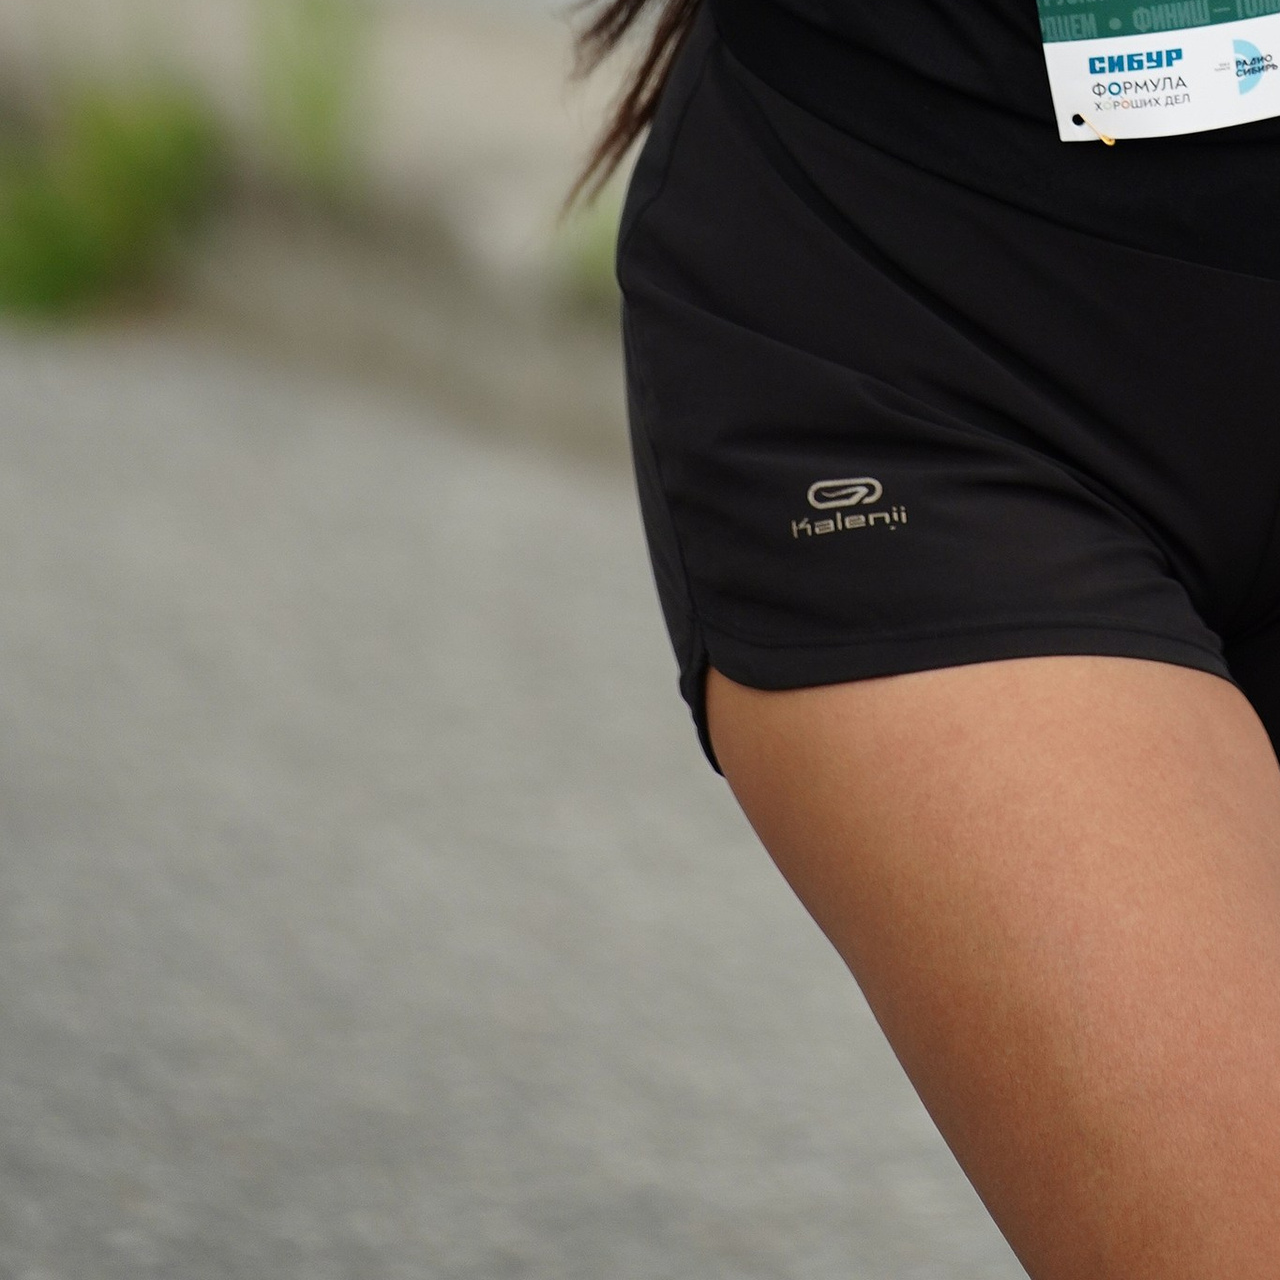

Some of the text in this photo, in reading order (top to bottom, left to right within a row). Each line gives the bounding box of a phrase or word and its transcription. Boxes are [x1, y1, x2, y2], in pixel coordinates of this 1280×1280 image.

[1088, 48, 1183, 75] СИБУР
[1235, 53, 1273, 69] РАДИО
[1092, 76, 1188, 97] ФОРМУЛА
[1094, 92, 1191, 112] ХОРОШИХ ДЕЛ
